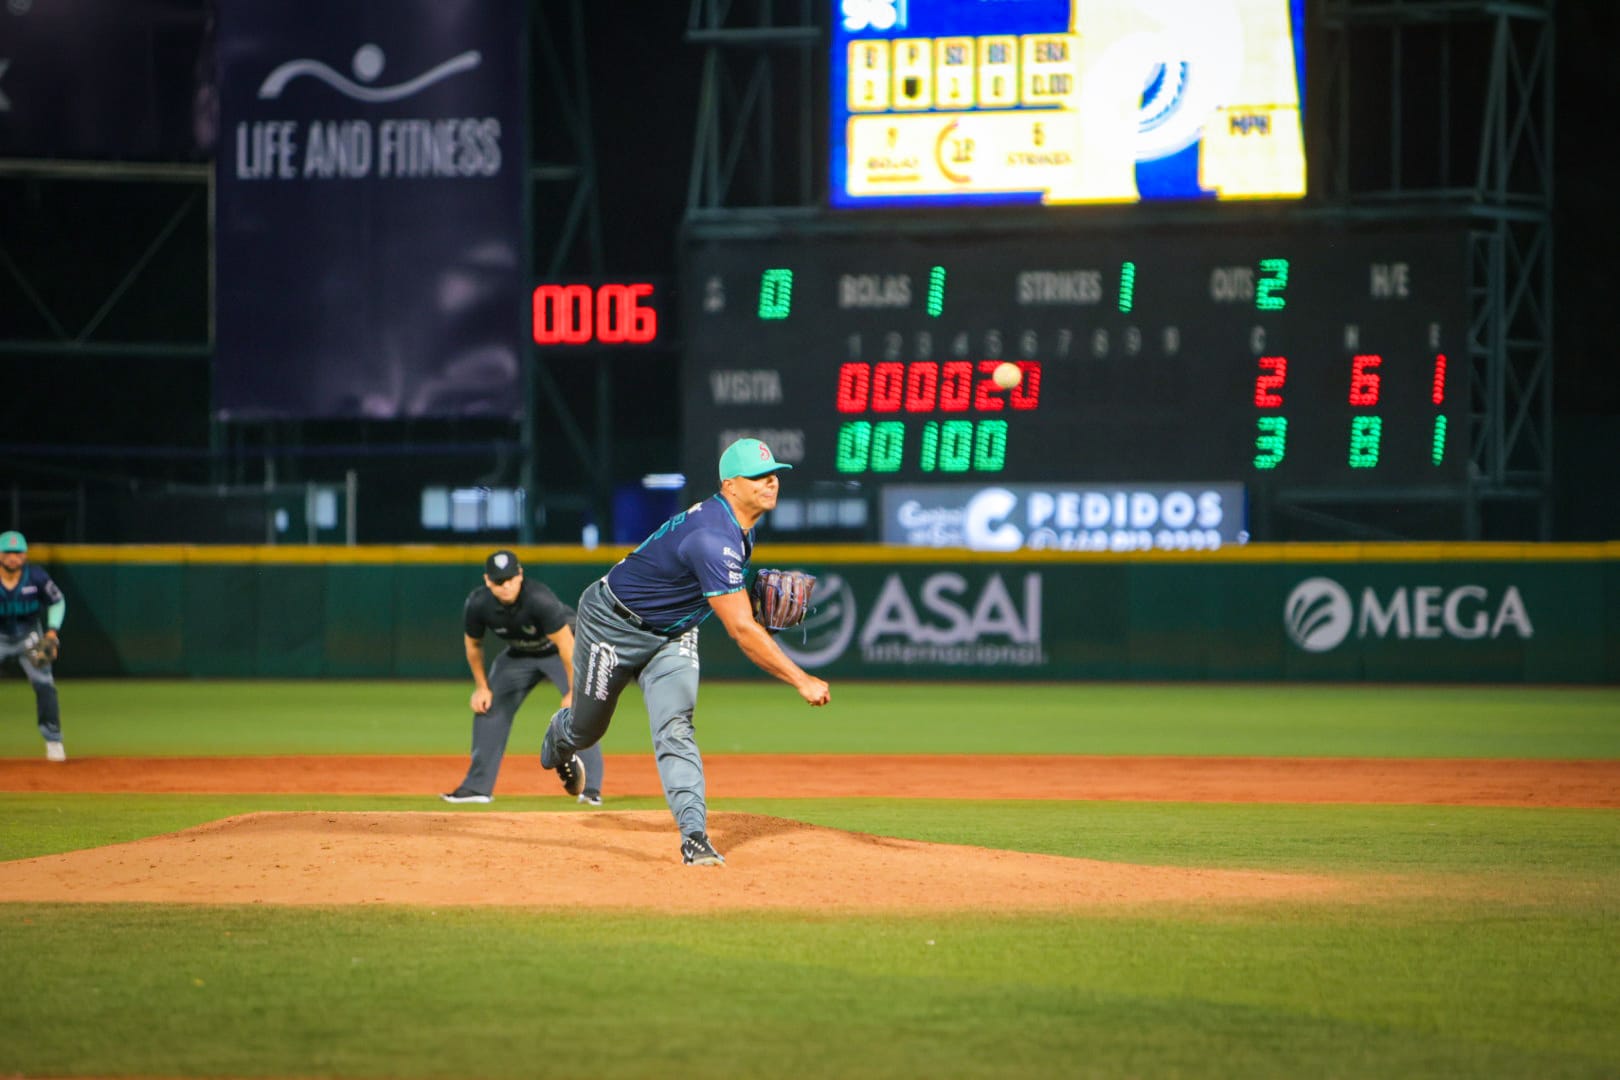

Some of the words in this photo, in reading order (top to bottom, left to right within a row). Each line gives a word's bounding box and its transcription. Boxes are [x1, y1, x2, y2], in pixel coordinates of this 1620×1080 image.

[236, 120, 298, 180] LIFE
[303, 119, 372, 179] AND
[379, 117, 502, 178] FITNESS
[927, 266, 946, 317] 1
[1017, 270, 1102, 306] STRIKES
[1118, 261, 1136, 313] 1
[1210, 267, 1255, 303] OUTS
[1255, 258, 1289, 310] 2
[1254, 356, 1287, 408] 2
[1349, 354, 1381, 406] 6
[1432, 354, 1446, 405] 1
[1253, 416, 1287, 469] 3
[1349, 416, 1382, 468] 8
[1432, 414, 1446, 466] 1
[1027, 490, 1223, 529] PEDIDOS
[860, 571, 1043, 644] ASAI
[1357, 584, 1535, 640] MEGA
